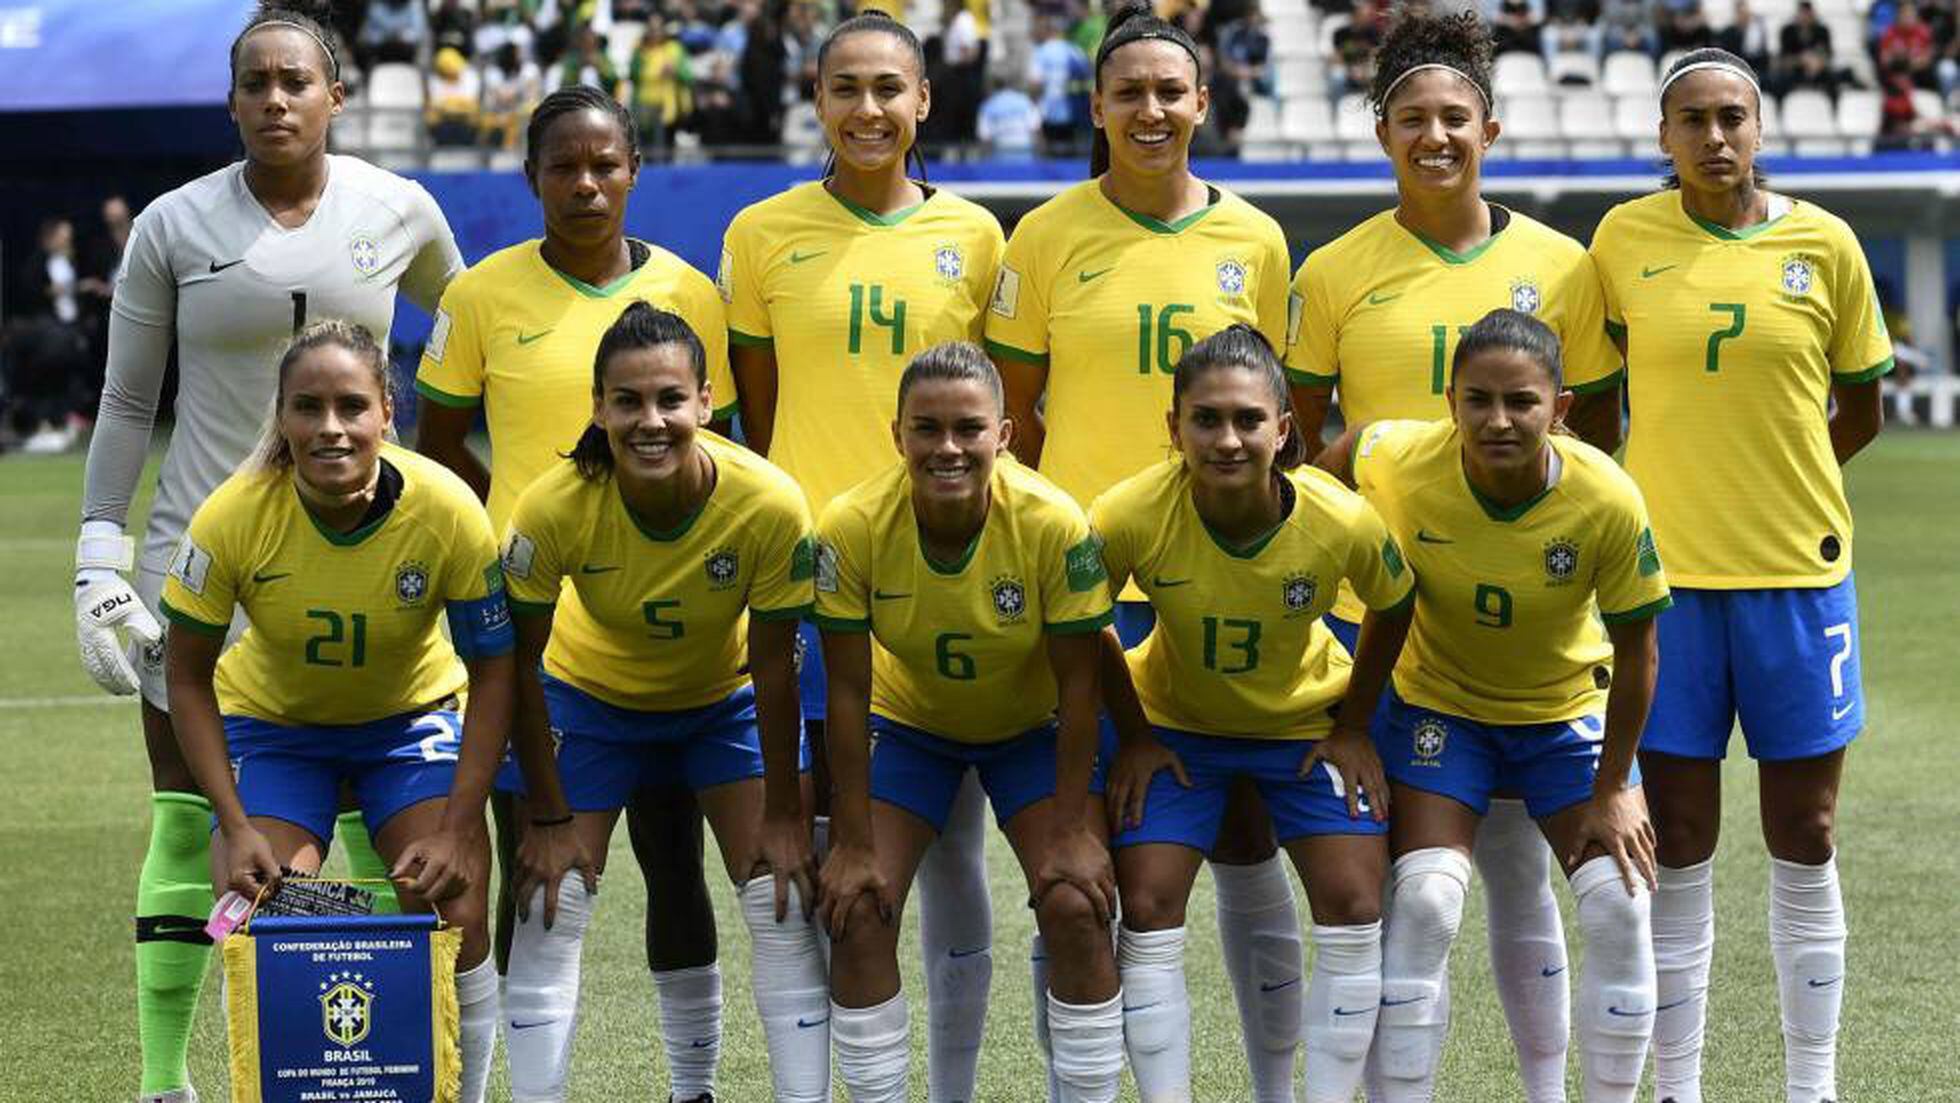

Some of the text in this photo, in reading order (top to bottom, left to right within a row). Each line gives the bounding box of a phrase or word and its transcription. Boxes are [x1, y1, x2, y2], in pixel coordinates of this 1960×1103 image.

[291, 291, 307, 331] 1
[848, 284, 907, 355] 14
[1137, 303, 1195, 375] 16
[1431, 324, 1473, 396] 1
[1706, 303, 1746, 373] 7
[642, 600, 684, 641] 5
[1475, 583, 1512, 628] 9
[305, 609, 366, 667] 21
[935, 632, 976, 681] 6
[1201, 616, 1262, 674] 13
[1824, 622, 1852, 698] 7
[412, 714, 459, 762] 2
[273, 939, 413, 952] CONFEDERAÇÃO BRASILEIRA
[313, 951, 374, 962] DE FUTEBOL
[277, 1068, 297, 1078] COPA
[298, 1067, 309, 1078] DO
[310, 1067, 338, 1077] MUNDO
[350, 1065, 383, 1076] FUTEBOL
[323, 1049, 373, 1063] BRASIL
[301, 1091, 337, 1101] BRASIL
[338, 1092, 351, 1100] vs
[351, 1087, 398, 1100] JAMAICA
[321, 1077, 355, 1088] FRANÇA
